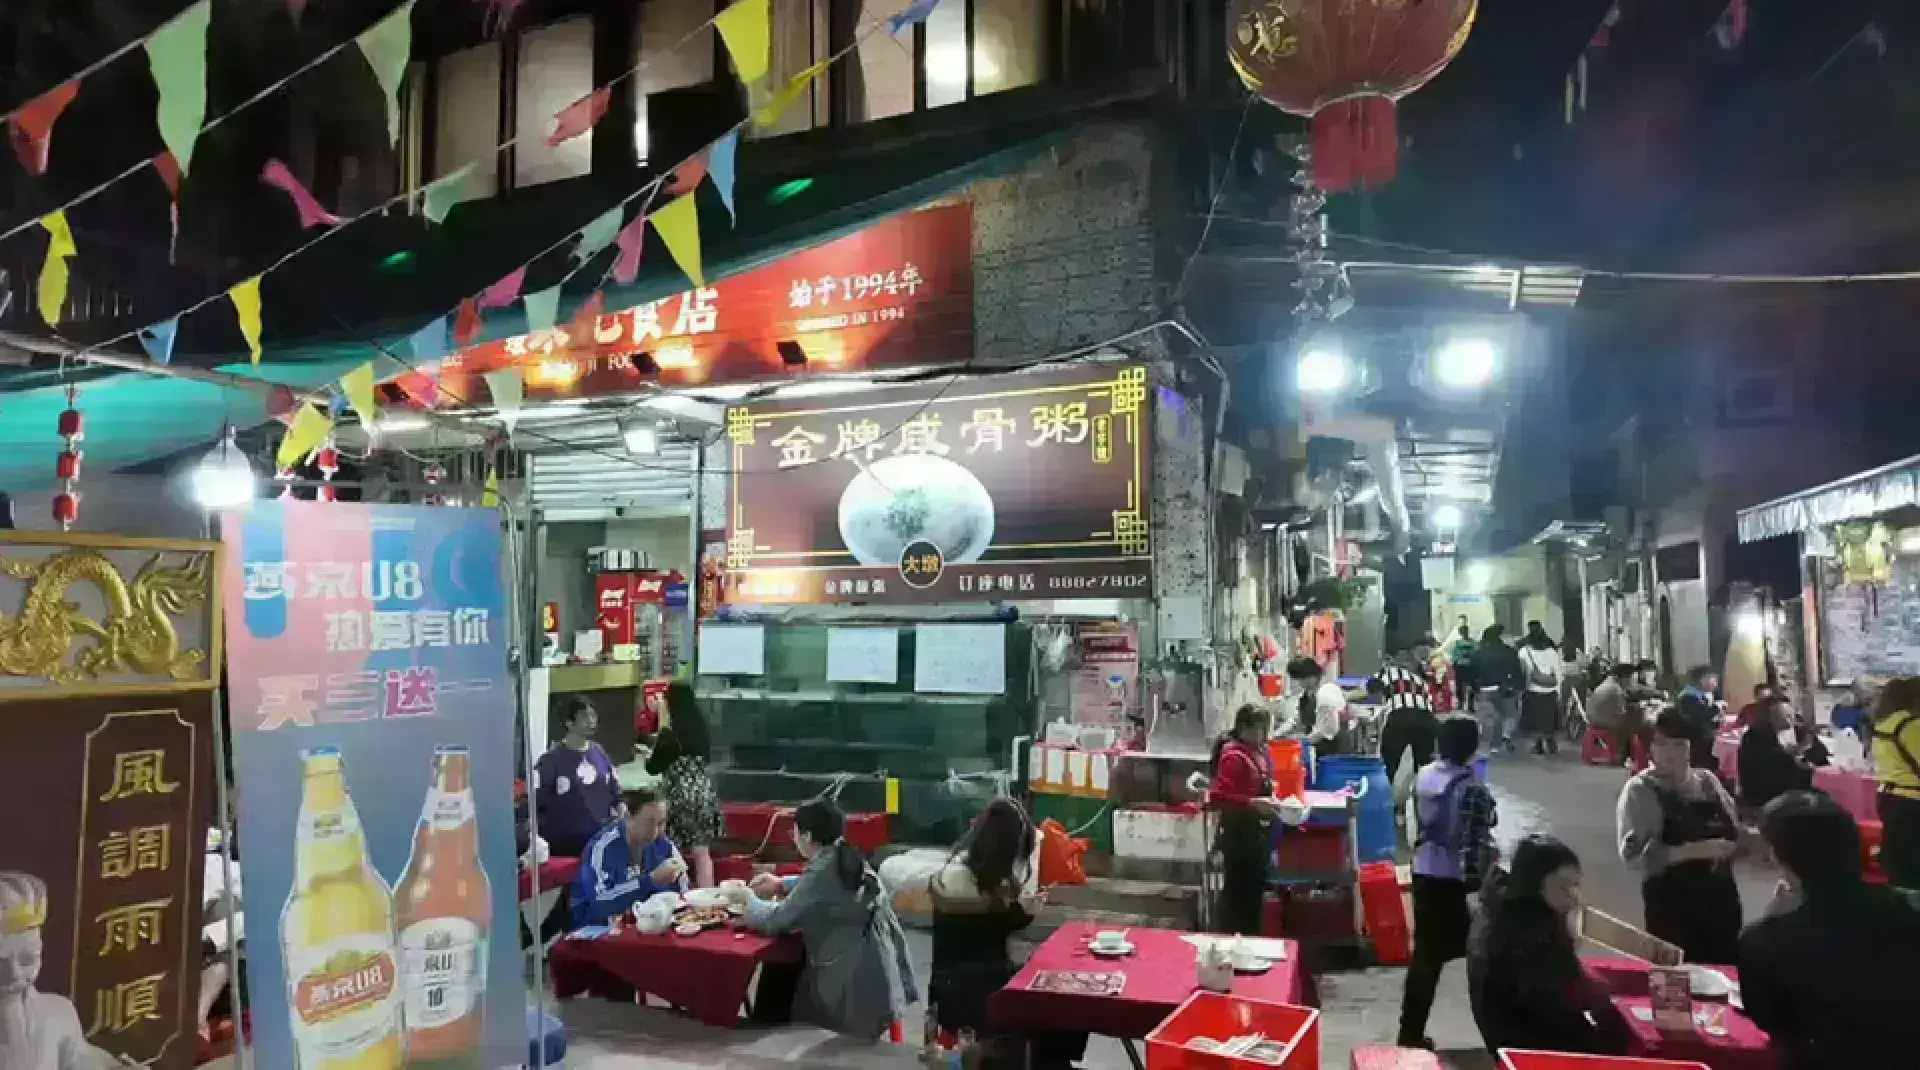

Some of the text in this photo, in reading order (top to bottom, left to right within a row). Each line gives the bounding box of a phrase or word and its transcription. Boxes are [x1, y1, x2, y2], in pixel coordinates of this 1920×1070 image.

[770, 402, 1088, 470] 金牌咸骨粥
[324, 606, 490, 652] 热爱有你
[257, 664, 493, 731] 买三送一
[86, 748, 181, 1037] 風調雨順
